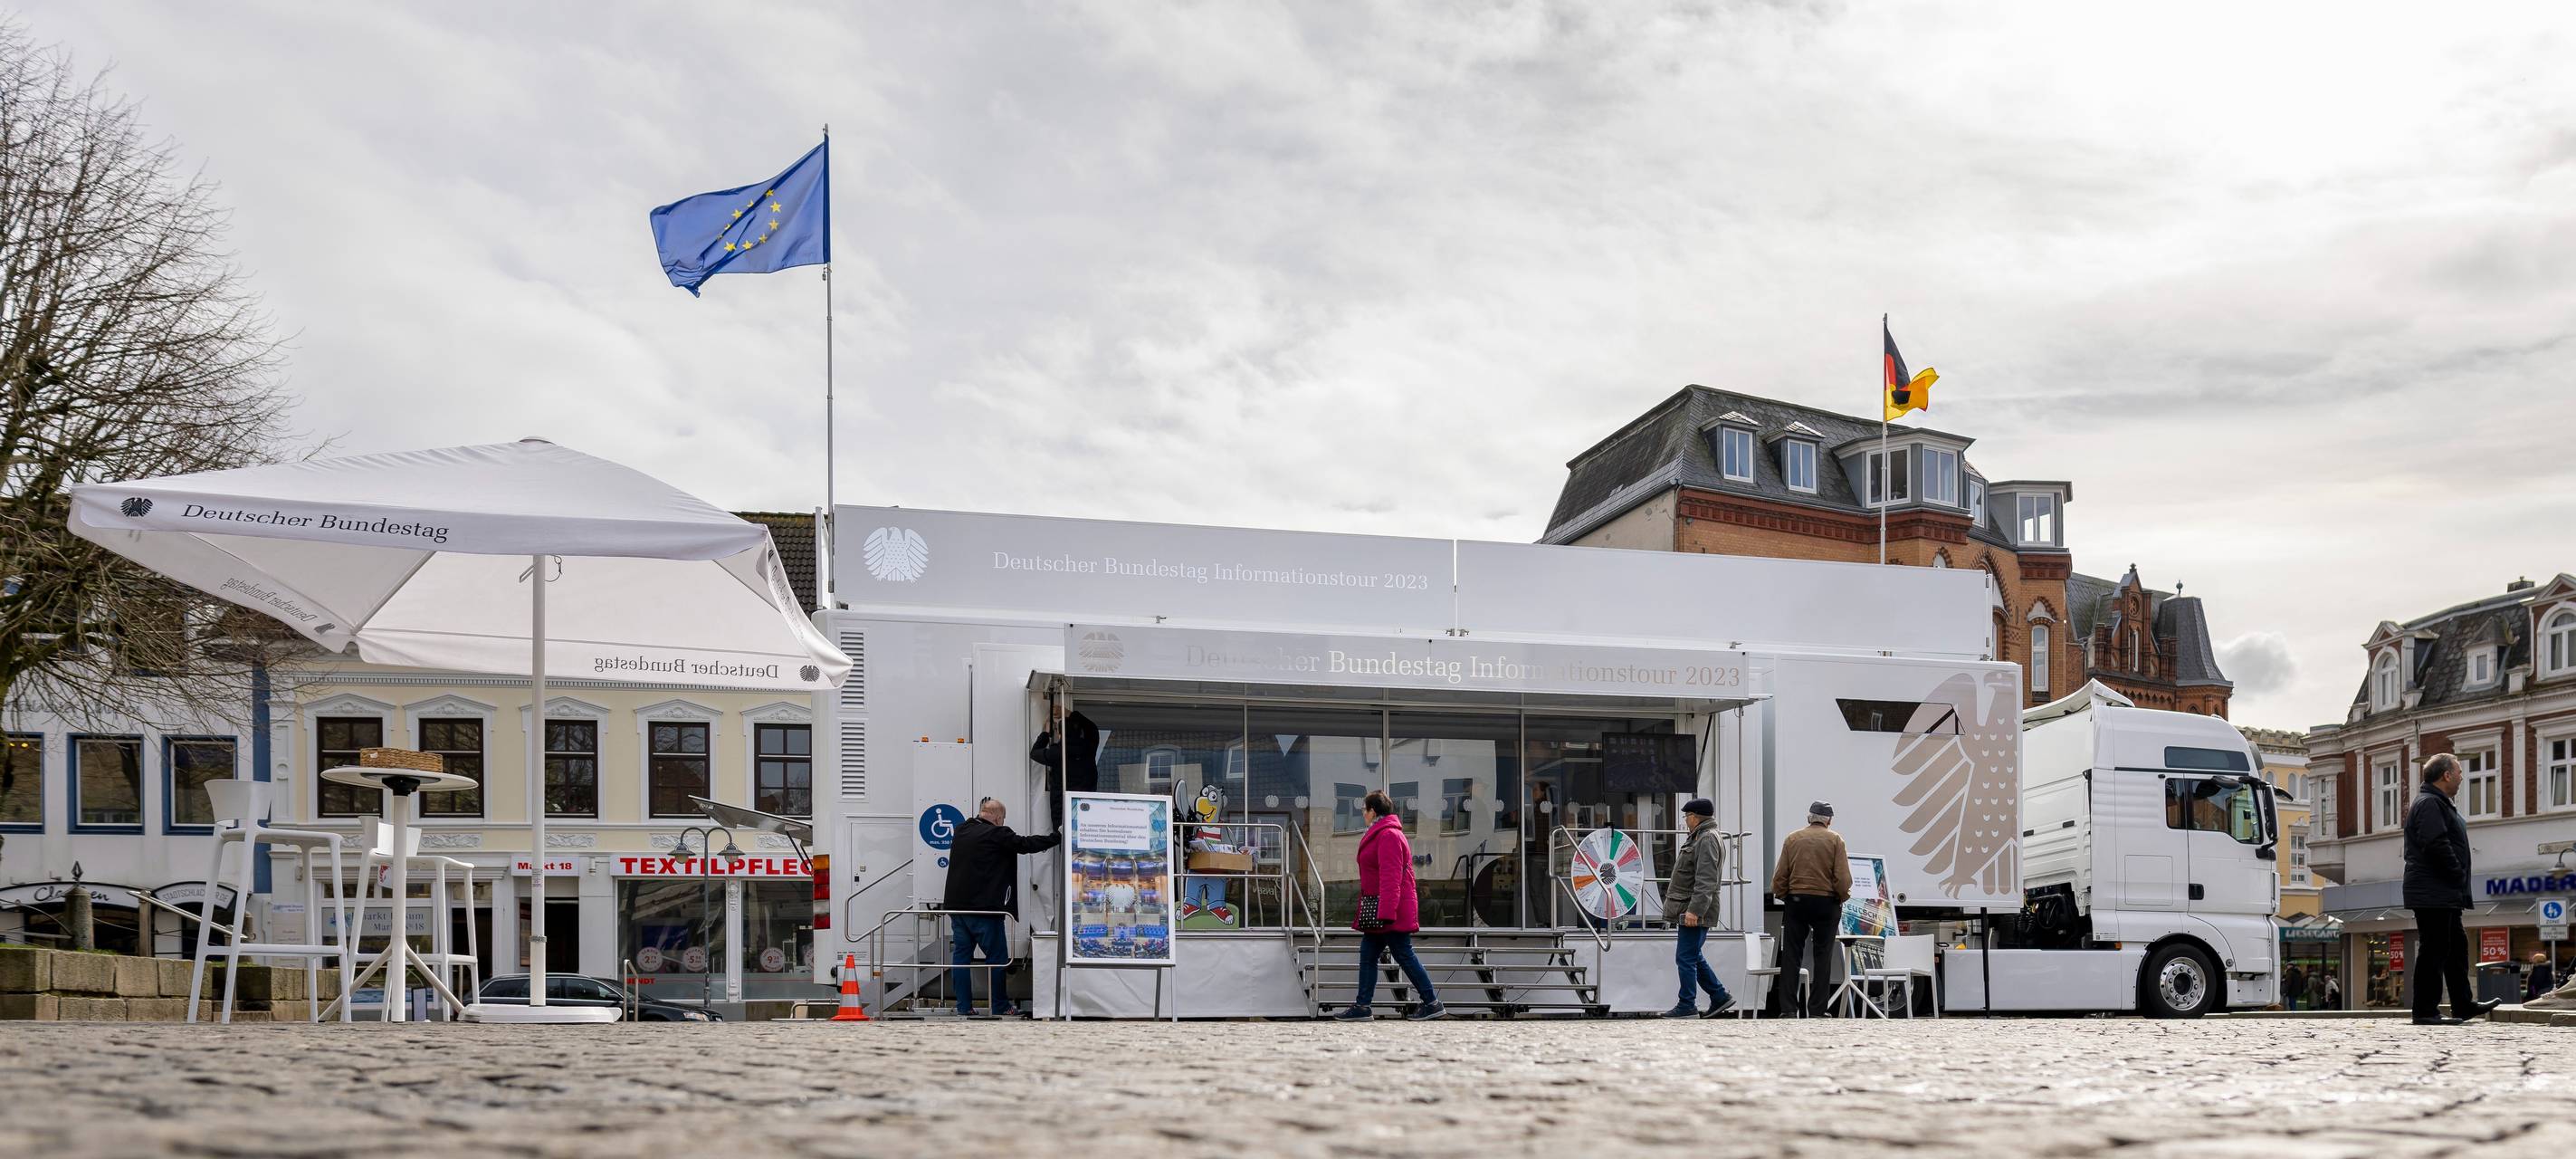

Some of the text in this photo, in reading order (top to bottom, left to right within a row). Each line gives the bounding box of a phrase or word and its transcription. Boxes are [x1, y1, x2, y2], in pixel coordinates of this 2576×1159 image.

[181, 504, 450, 543] Deutscher Bundestag
[992, 551, 1428, 590] Deutscher Bundestag Informationstour 2023
[1328, 650, 1463, 683] Bundestag
[1469, 656, 1677, 685] Informationstour
[1685, 666, 1741, 687] 2023
[518, 862, 573, 870] Mkt 18
